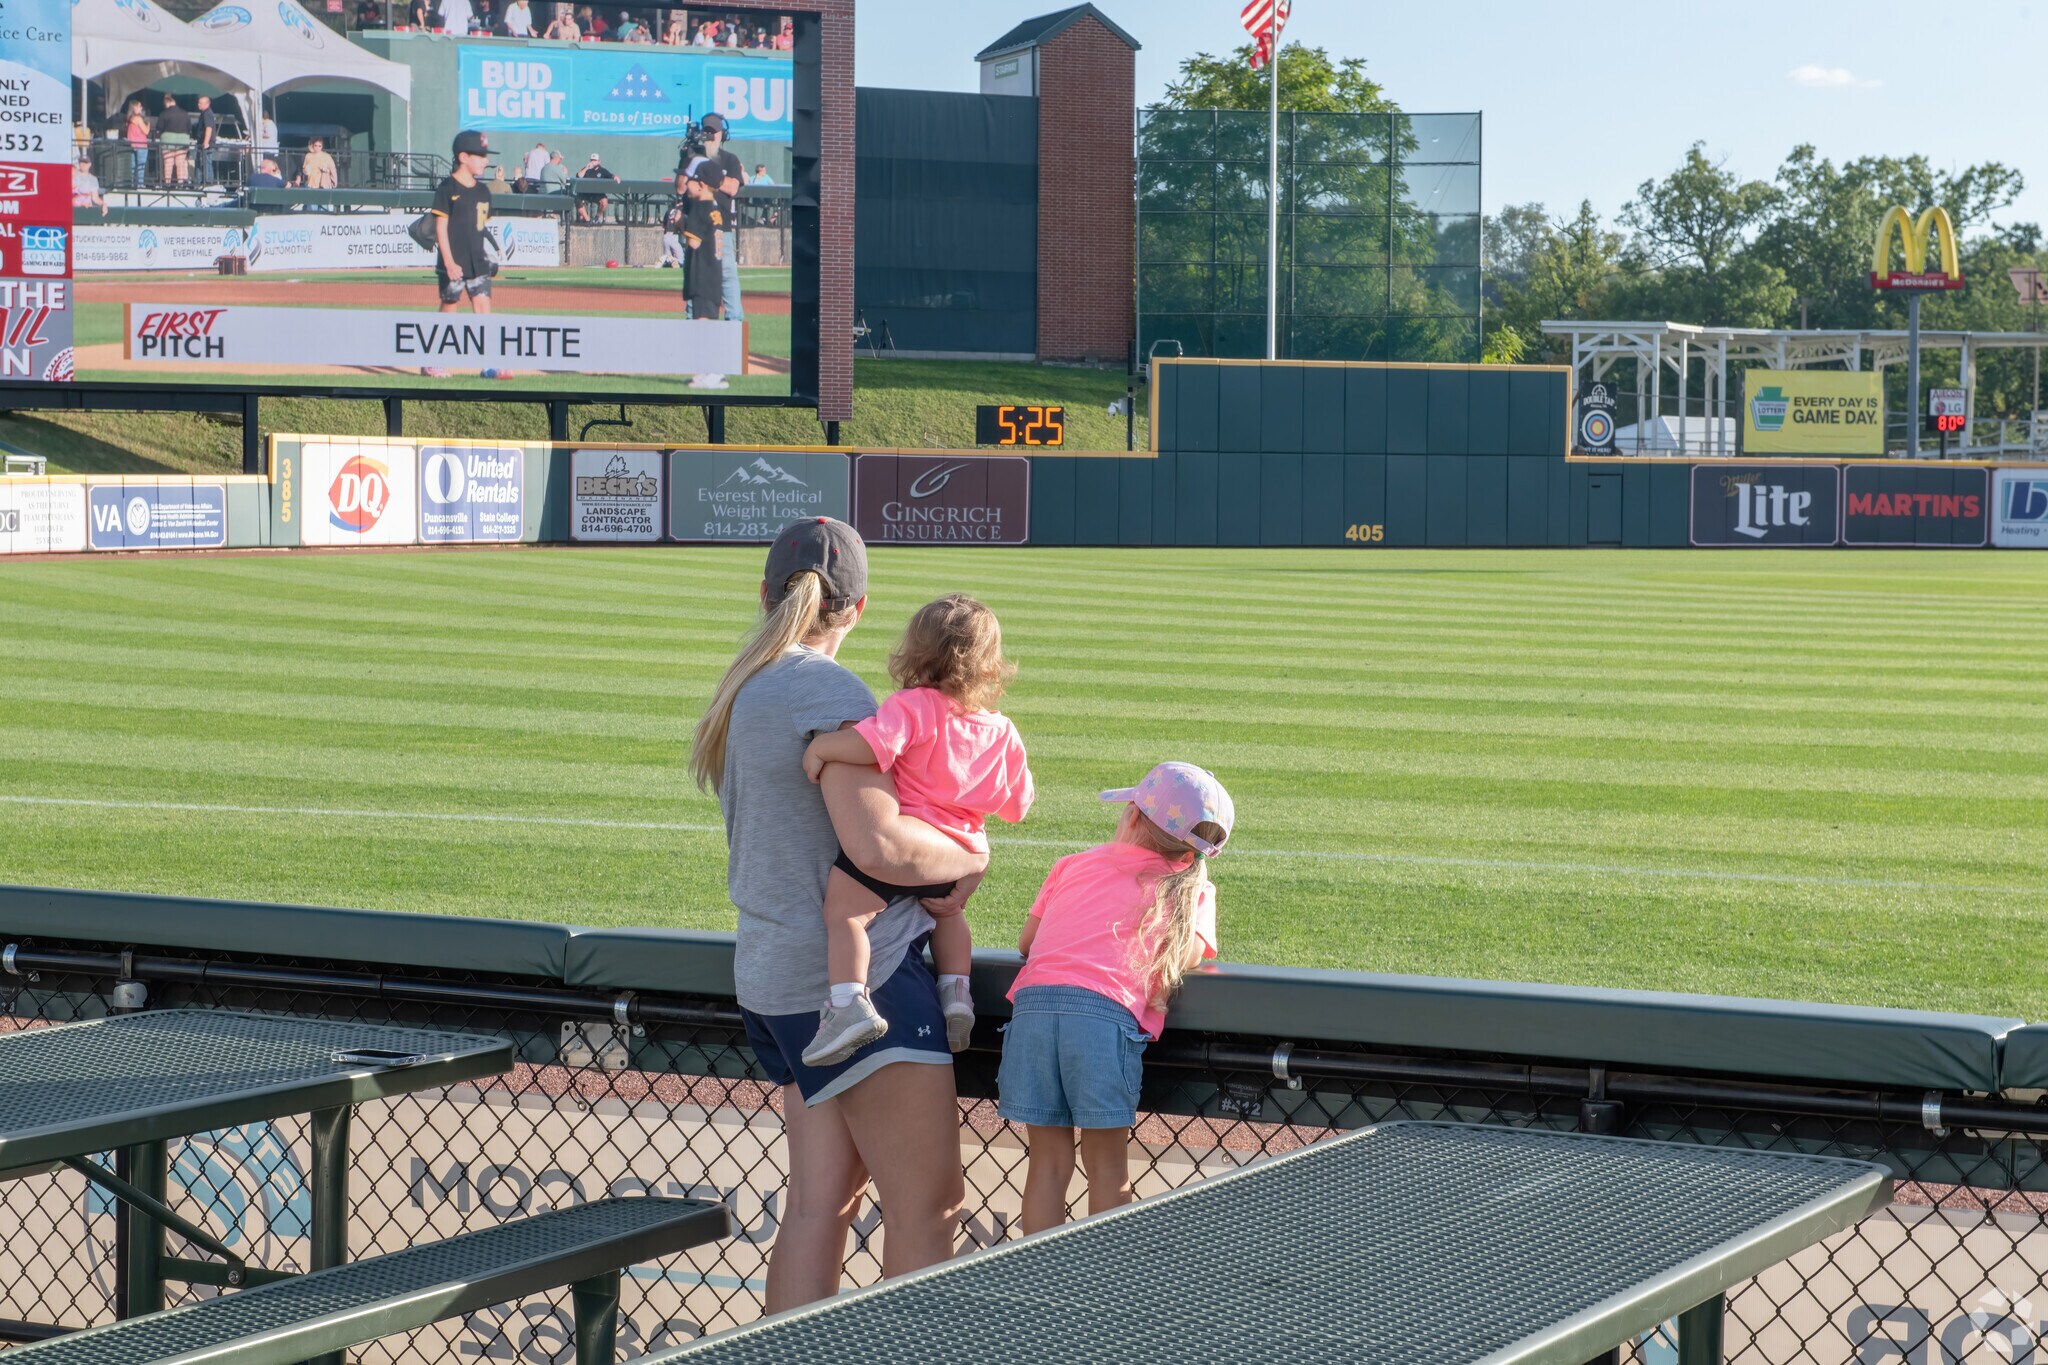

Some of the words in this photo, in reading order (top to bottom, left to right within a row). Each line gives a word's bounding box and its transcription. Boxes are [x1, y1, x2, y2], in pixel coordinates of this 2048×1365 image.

[26, 26, 62, 42] Care
[482, 60, 552, 90] BUD
[713, 75, 793, 122] BU
[584, 110, 625, 123] FOLDS
[627, 111, 640, 125] of
[0, 134, 43, 153] 532
[264, 229, 313, 244] STUCKEY
[320, 225, 362, 236] ALTOONA
[370, 224, 410, 236] HOLLIDA
[517, 231, 555, 243] STUCKEY
[20, 228, 65, 249] LGR
[208, 236, 222, 245] FOR
[264, 245, 313, 256] AUTOMOTIVE
[348, 244, 374, 255] STATE
[376, 242, 414, 254] COLLEGE
[518, 245, 555, 254] AUTOMOTIVE
[1891, 278, 1945, 287] McDonald's
[137, 309, 228, 338] FIRST
[142, 335, 224, 358] PITCH
[395, 323, 485, 355] EVAN
[500, 326, 580, 357] HITE
[1794, 396, 1834, 407] EVERY
[1839, 397, 1863, 407] DAY
[1866, 398, 1878, 408] IS
[1948, 403, 1962, 413] LG
[1793, 409, 1840, 424] GAME
[1845, 410, 1878, 425] DAY.
[999, 406, 1062, 445] 5:25
[467, 455, 516, 478] United
[281, 458, 292, 522] 385
[466, 480, 519, 504] Rentals
[1720, 473, 1761, 498] Miller
[338, 473, 384, 518] DQ
[699, 488, 756, 503] Everest
[762, 489, 822, 503] Medical
[586, 507, 647, 516] LANDSCAPE
[712, 504, 767, 520] Weight
[773, 505, 807, 518] Loss
[1733, 483, 1811, 538] Lite
[1849, 493, 1980, 518] MARTIN'S
[93, 504, 123, 532] VA
[424, 512, 468, 523] Duncansville
[480, 512, 496, 522] State
[497, 512, 519, 524] College
[581, 516, 651, 524] CONTRACTOR
[581, 525, 653, 533] 814-696-4700
[704, 522, 786, 536] 814-283-4
[882, 524, 1001, 540] INSURANCE
[1345, 524, 1384, 542] 405
[2001, 526, 2040, 537] Heating
